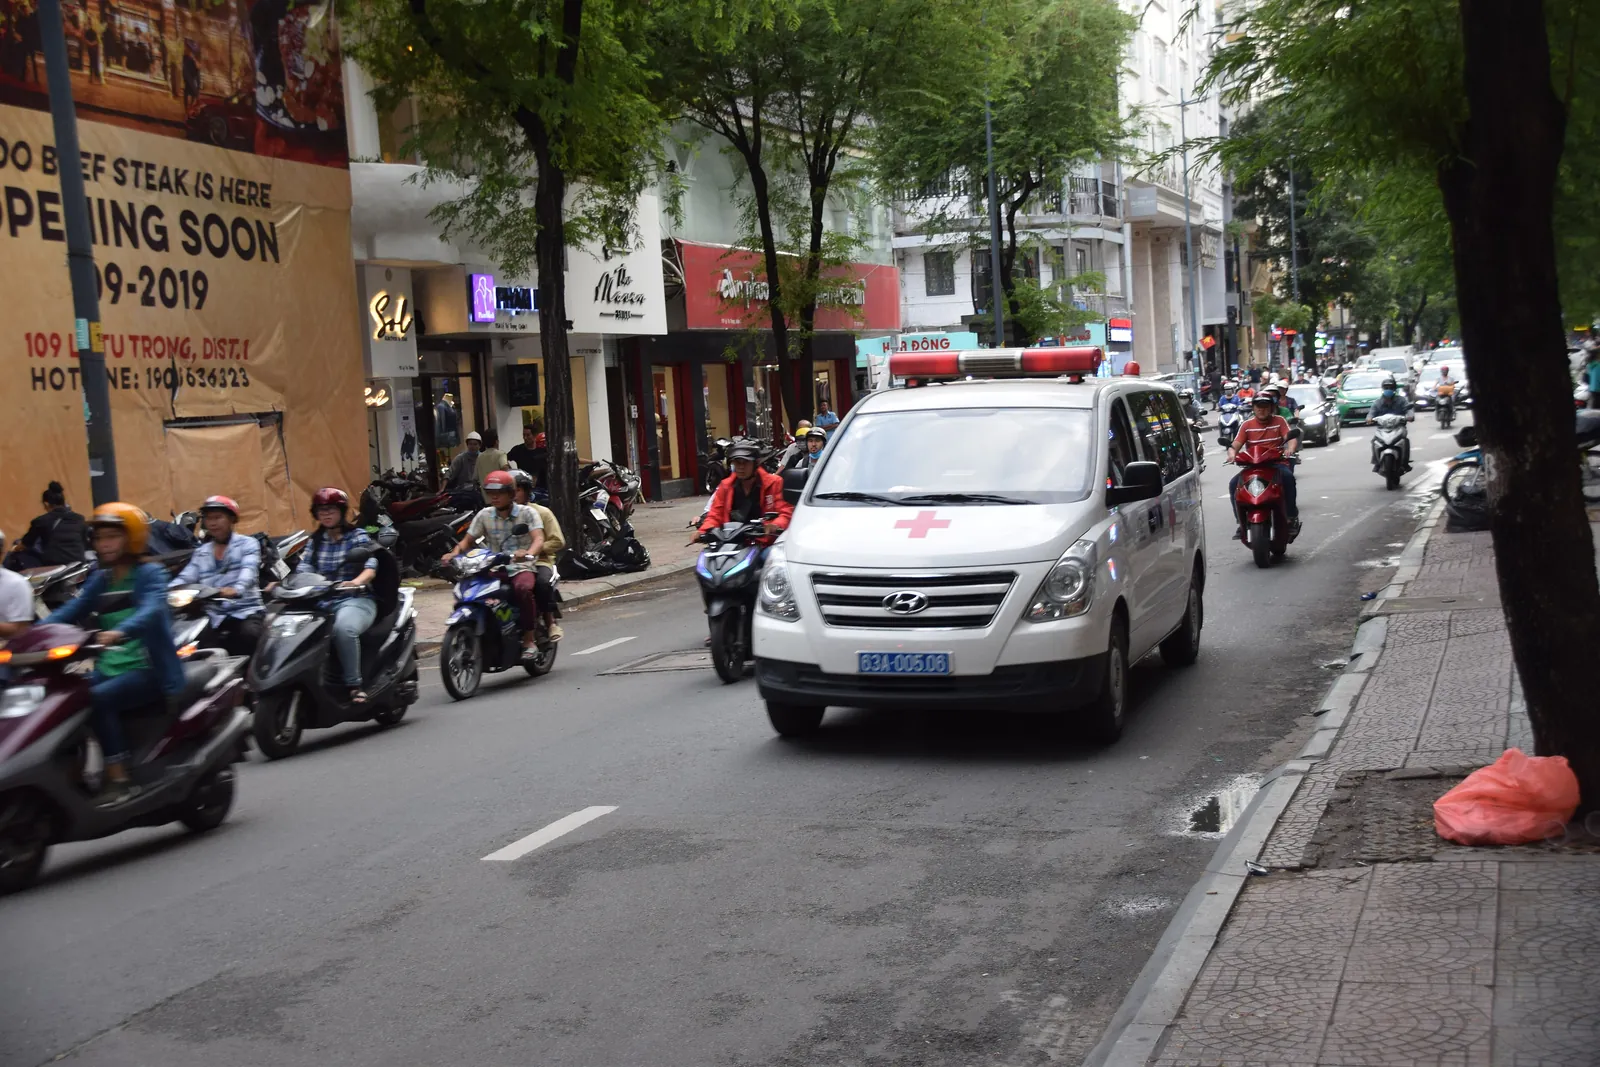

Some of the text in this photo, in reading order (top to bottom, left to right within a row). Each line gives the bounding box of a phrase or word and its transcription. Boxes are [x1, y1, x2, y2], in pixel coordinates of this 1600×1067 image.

[42, 144, 106, 182] BEF
[113, 157, 190, 197] STEAK
[195, 171, 214, 201] IS
[220, 176, 272, 209] HERE
[0, 185, 280, 264] PEING SOON
[98, 261, 209, 310] 9-2019
[25, 332, 62, 358] 109
[68, 333, 80, 358] L
[128, 335, 197, 363] TRONG,
[883, 337, 950, 353] HA ĐÔNG
[31, 367, 139, 391] HOTNE:
